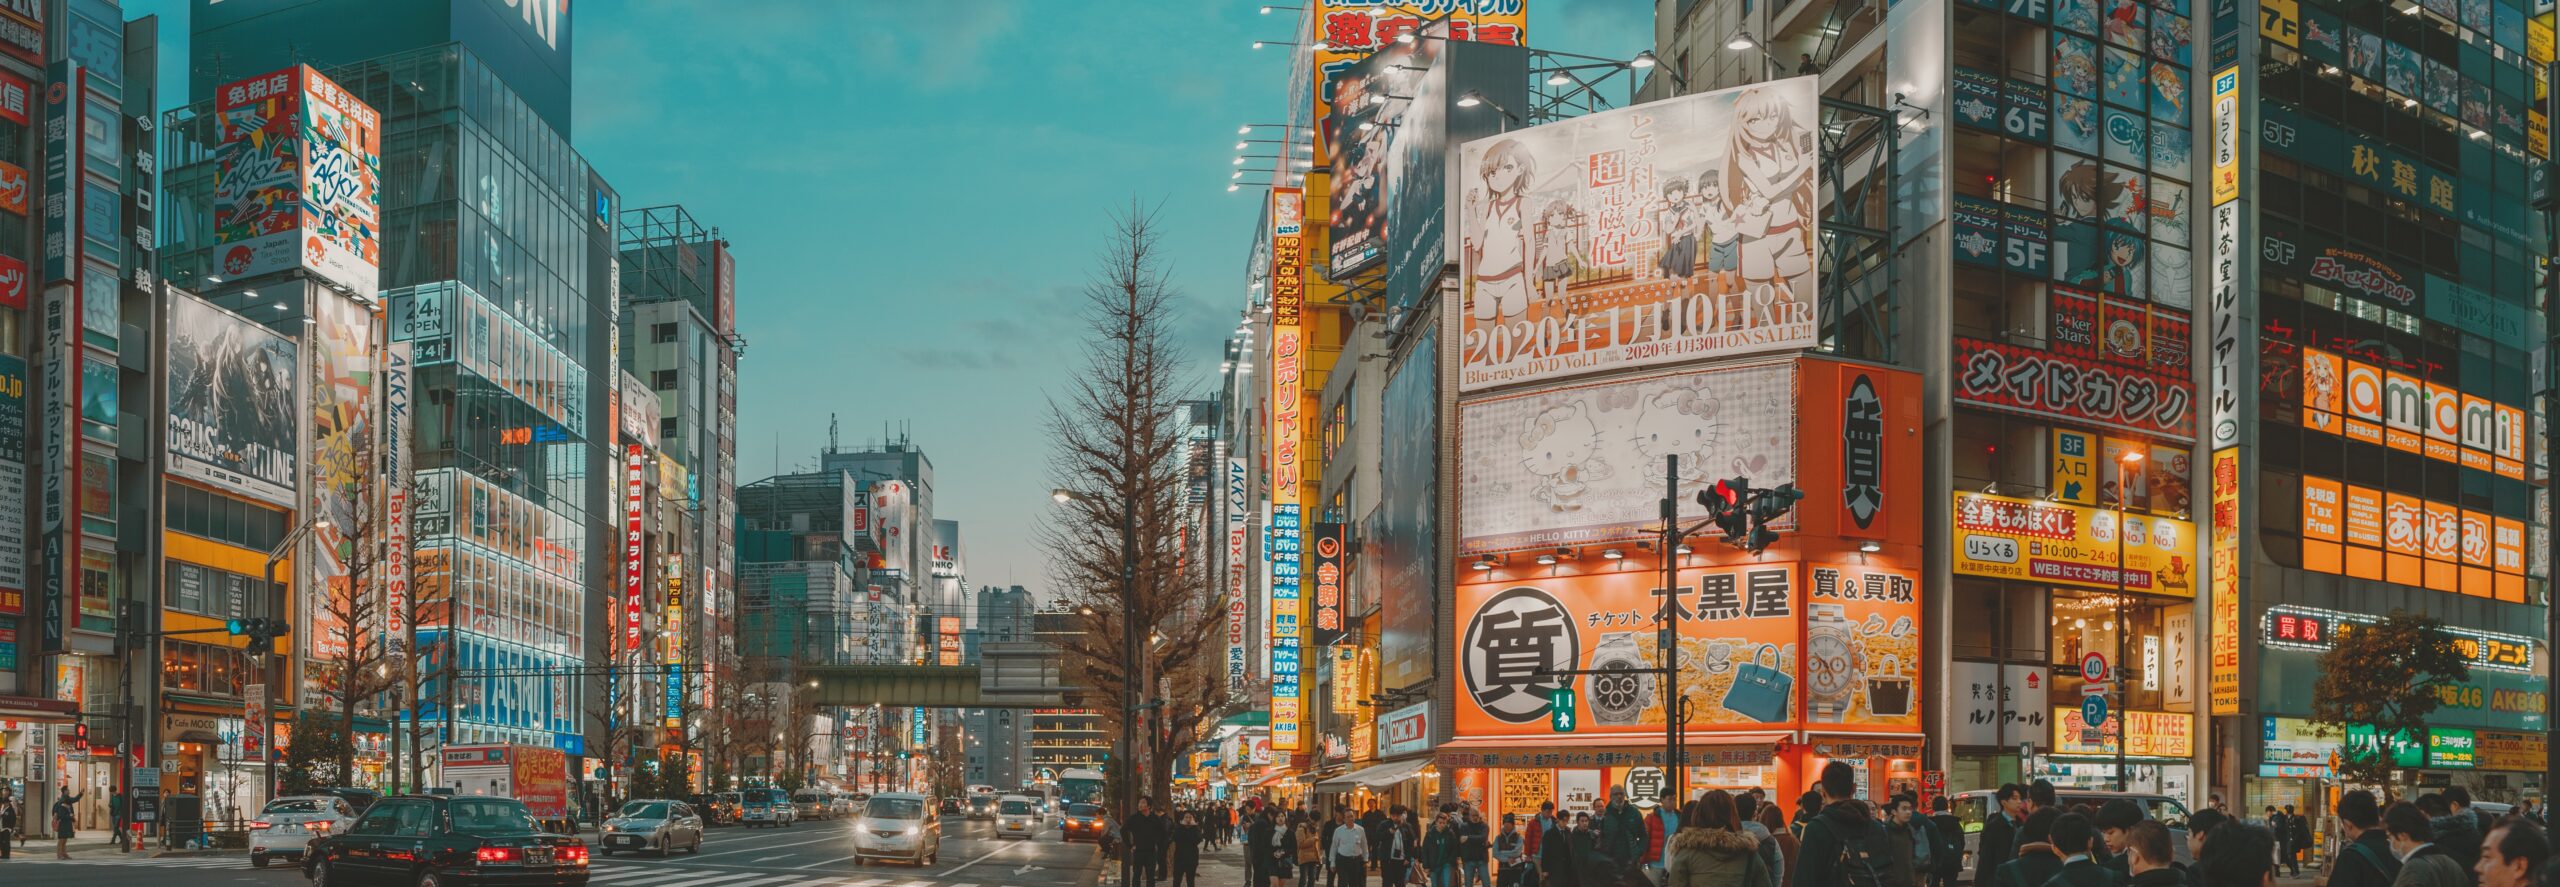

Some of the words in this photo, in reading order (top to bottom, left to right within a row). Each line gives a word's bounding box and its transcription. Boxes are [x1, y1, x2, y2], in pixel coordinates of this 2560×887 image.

[2260, 5, 2298, 38] 7F
[228, 73, 288, 106] 免税店
[2218, 78, 2233, 93] 3F
[0, 82, 24, 116] 信
[310, 72, 375, 132] 愛客免税店
[2004, 108, 2046, 138] 6F
[2221, 100, 2230, 164] りらくる
[2263, 119, 2296, 148] 5F
[1628, 114, 1657, 238] とある科学の
[2351, 143, 2455, 213] 秋葉館
[47, 115, 65, 261] 愛三電機
[1588, 148, 1627, 268] 超電磁砲
[136, 149, 153, 293] 坂口電熱
[1278, 238, 1299, 247] DVD
[2219, 206, 2233, 283] 喫茶室
[2263, 236, 2296, 265] 5F
[1277, 257, 1299, 266] ゲーム
[2005, 237, 2046, 270] 5F
[1276, 276, 1298, 286] アイドル
[1280, 266, 1295, 276] CD
[1276, 286, 1299, 296] アニメ
[1276, 296, 1298, 306] コミック
[1755, 282, 1797, 307] ON
[406, 298, 441, 320] 24h
[1277, 306, 1298, 315] ホビー
[1757, 302, 1815, 330] AIR
[404, 320, 441, 334] OPEN
[1463, 288, 1752, 368] 2020年1月10日
[2055, 326, 2092, 346] Stars
[1625, 335, 1725, 361] 2020年4月30日
[1726, 333, 1750, 348] ON
[1754, 323, 1812, 346] SALE!!
[2215, 285, 2237, 416] ルノアール
[1564, 351, 1597, 371] Vol.1
[390, 351, 406, 416] AKKY
[1964, 351, 2187, 428] メイドカジノ
[2348, 366, 2512, 457] amiami
[389, 406, 401, 488] INTERNATIONAL
[2062, 437, 2083, 454] 3F
[2056, 457, 2088, 477] 入口
[415, 477, 439, 495] 4h
[1230, 461, 1244, 511] AKKY
[2305, 485, 2336, 504] 免税店
[1284, 505, 1299, 515] 中古
[1962, 501, 2071, 536] 全身もみほぐし
[2309, 502, 2333, 519] Tax
[389, 490, 406, 577] Tax-free
[1273, 528, 1284, 538] 5F
[1284, 528, 1299, 538] 中古
[1276, 519, 1298, 528] DVD
[2090, 526, 2115, 541] No.1
[2306, 519, 2336, 536] Free
[2387, 502, 2490, 562] あみあみ
[1529, 532, 1560, 543] HELLO
[1563, 529, 1591, 540] KITTY
[2152, 534, 2177, 548] No.1
[1275, 542, 1298, 551] DVD
[1968, 539, 2015, 559] りらくる
[1230, 527, 1245, 598] Tax-free
[1273, 553, 1284, 562] 4F
[1284, 552, 1299, 562] 中古
[1275, 566, 1298, 575] DVD
[1960, 561, 2023, 577] 秋葉原中央通り店
[2033, 561, 2061, 576] WEB
[2226, 546, 2238, 595] TAX
[46, 536, 59, 639] AISAN
[1273, 576, 1284, 585] 3F
[1284, 576, 1299, 586] 中古
[1650, 567, 1791, 622] 大黒屋
[389, 580, 405, 632] Shop
[2213, 549, 2227, 668] 면세점
[1230, 602, 1245, 644] Shop
[1276, 614, 1297, 625] 買取
[1587, 609, 1643, 628] チケット
[1276, 625, 1297, 635] フロア
[2226, 603, 2238, 668] FREE
[2279, 616, 2319, 642] 買取
[669, 620, 680, 660] DVD
[1283, 637, 1298, 647] 中古
[1273, 650, 1298, 660] TVゲーム
[1474, 604, 1566, 706] 質
[2487, 639, 2527, 665] アニメ
[1274, 661, 1298, 672] DVD
[2086, 660, 2101, 676] 40
[2146, 646, 2155, 688] ルノアール
[2173, 630, 2185, 699] ルノアール
[1285, 674, 1298, 684] 中古
[2213, 683, 2238, 695] AKIHABARA
[1971, 683, 2012, 702] 喫茶室
[1969, 708, 2045, 727] ルノアール
[2087, 703, 2098, 723] P
[174, 718, 190, 730] Cafe
[190, 718, 216, 731] MOCO
[1274, 722, 1297, 731] AKIBA
[2130, 712, 2154, 736] TAX
[2156, 714, 2185, 737] FREE
[1835, 743, 1919, 757] 1階にて高価買取中
[2132, 736, 2186, 755] 면세점
[1720, 750, 1773, 765] 無料査定
[1629, 769, 1661, 803] 質
[1925, 773, 1940, 786] 4F
[1566, 793, 1593, 803] 大黒屋
